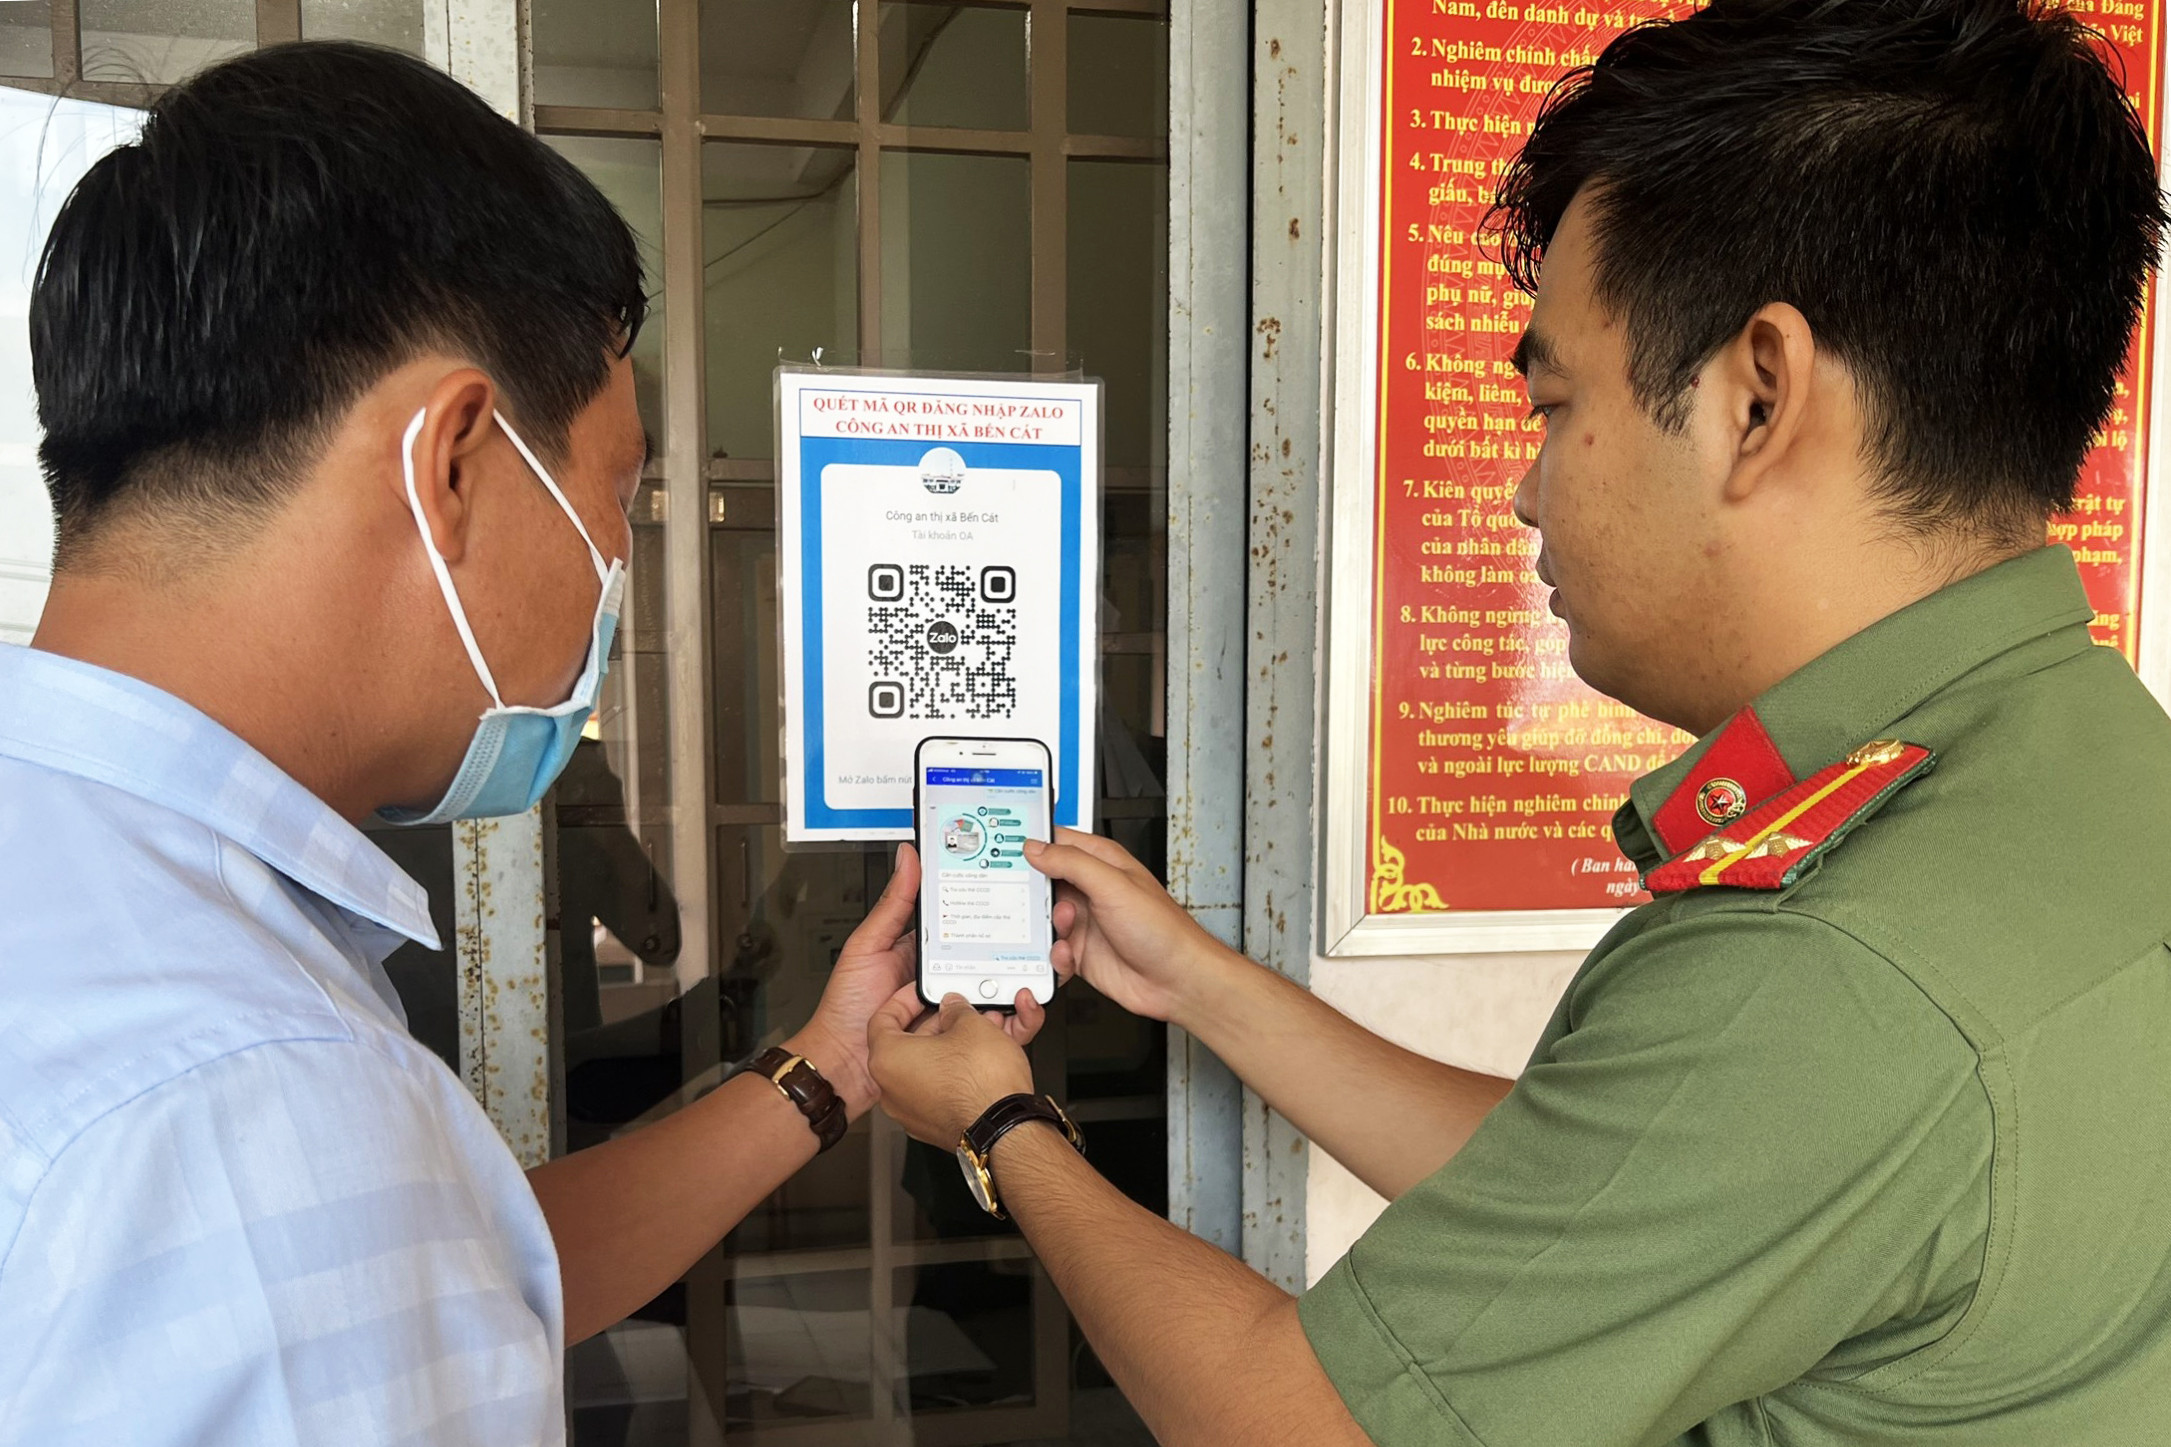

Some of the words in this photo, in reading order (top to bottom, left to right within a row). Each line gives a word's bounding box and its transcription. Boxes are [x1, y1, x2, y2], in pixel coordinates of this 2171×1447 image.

[1432, 0, 1481, 21] Nam,
[1524, 4, 1569, 24] danh
[1574, 8, 1600, 31] dự
[2110, 24, 2143, 47] Việt
[1411, 37, 1427, 56] 2.
[1431, 38, 1501, 63] Nghiêm
[1431, 68, 1487, 93] nhiệm
[1493, 77, 1514, 96] vụ
[1410, 109, 1426, 128] 3.
[1430, 110, 1478, 136] Thực
[1484, 114, 1521, 138] hiện
[1409, 152, 1425, 171] 4.
[1430, 153, 1486, 179] Trung
[1428, 177, 1473, 206] giấu,
[1408, 223, 1424, 242] 5.
[1428, 224, 1464, 244] Nêu
[1427, 254, 1473, 279] đúng
[1426, 284, 1461, 306] phụ
[1468, 286, 1497, 307] nữ,
[1426, 312, 1465, 331] sách
[1471, 311, 1519, 333] nhiễu
[1405, 352, 1421, 370] 6.
[1426, 353, 1485, 378] Không
[1425, 382, 1473, 405] kiệm,
[1480, 384, 1522, 406] liêm,
[813, 395, 859, 412] QUÉT
[863, 398, 889, 412] MÃ
[894, 400, 917, 415] QR
[922, 400, 967, 415] ĐĂNG
[972, 403, 1016, 419] NHẬP
[1019, 406, 1063, 419] ZALO
[836, 418, 883, 434] CÔNG
[887, 423, 910, 435] AN
[914, 423, 942, 438] THỊ
[947, 423, 969, 437] XÃ
[1010, 424, 1042, 439] CÁT
[1424, 407, 1478, 434] quyền
[1484, 413, 1516, 435] hạn
[1423, 440, 1465, 457] dưới
[1470, 435, 1499, 459] bất
[1504, 441, 1520, 460] kì
[1403, 480, 1419, 497] 7.
[1424, 480, 1465, 499] Kiên
[1471, 478, 1519, 504] quyế
[885, 510, 912, 523] Công
[915, 514, 928, 522] an
[930, 511, 943, 523] thị
[945, 512, 957, 522] xã
[960, 512, 979, 523] Bến
[981, 512, 999, 523] Cát
[1422, 508, 1453, 527] của
[1457, 504, 1482, 527] Tổ
[2106, 496, 2126, 515] tự
[912, 530, 926, 540] Tài
[928, 530, 957, 540] khoản
[959, 531, 973, 540] OA
[2081, 520, 2123, 541] pháp
[1421, 537, 1452, 555] của
[1457, 538, 1501, 556] nhân
[1421, 565, 1476, 587] không
[1481, 565, 1514, 583] làm
[1401, 605, 1416, 623] 8.
[1421, 605, 1480, 628] Không
[1485, 610, 1541, 628] ngừng
[929, 632, 957, 643] Zalo
[1420, 634, 1448, 655] lực
[1452, 633, 1494, 655] công
[1499, 633, 1529, 653] tác,
[1420, 661, 1440, 678] và
[1446, 661, 1487, 683] từng
[1399, 702, 1415, 720] 9.
[1419, 701, 1487, 724] Nghiêm
[1496, 702, 1524, 718] túc
[1531, 703, 1551, 722] tự
[1558, 703, 1589, 721] phê
[1418, 729, 1482, 751] thương
[1487, 729, 1517, 750] yêu
[1521, 728, 1560, 750] giúp
[1564, 727, 1587, 745] đỡ
[1591, 723, 1633, 748] đồng
[1636, 726, 1668, 746] chí,
[1417, 756, 1438, 774] và
[1444, 756, 1492, 778] ngoài
[1497, 756, 1524, 777] lực
[1529, 756, 1579, 777] lượng
[1584, 754, 1642, 773] CAND
[855, 775, 875, 784] Zalo
[898, 775, 912, 784] nút
[1388, 797, 1411, 814] 10.
[1417, 796, 1464, 817] Thực
[1470, 794, 1507, 816] hiện
[1514, 794, 1577, 816] nghiêm
[1416, 823, 1447, 841] của
[1453, 822, 1488, 840] Nhà
[1495, 822, 1537, 840] nước
[1543, 821, 1563, 838] và
[1568, 821, 1596, 838] các
